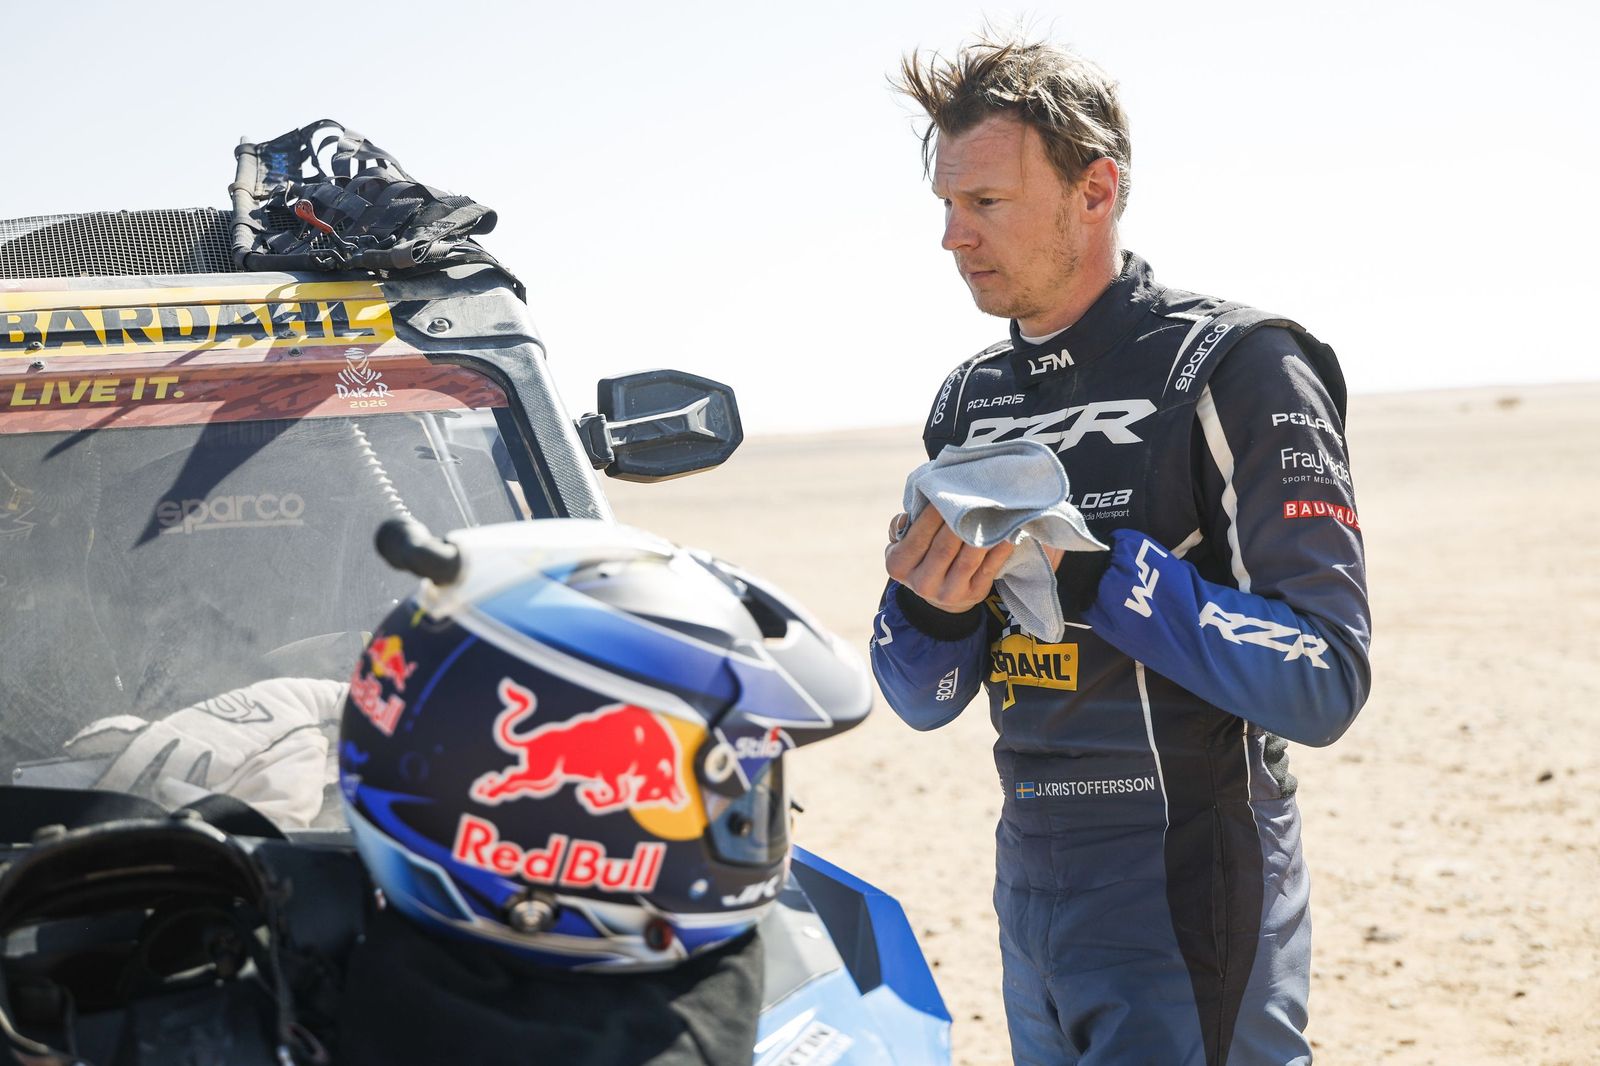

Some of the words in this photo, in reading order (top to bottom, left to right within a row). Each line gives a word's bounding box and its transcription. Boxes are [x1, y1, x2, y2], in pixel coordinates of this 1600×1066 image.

[0, 301, 375, 352] BARDAHL
[1028, 349, 1075, 375] LFM
[1175, 323, 1234, 392] sparco
[10, 379, 120, 406] LIVE
[131, 375, 185, 400] IT.
[335, 382, 395, 399] DAKAR
[966, 393, 1025, 412] POLARIS
[350, 400, 388, 409] 2026
[959, 399, 1158, 455] RZR
[1271, 412, 1343, 448] POLARIS
[1282, 475, 1311, 485] SPORT
[1314, 476, 1338, 486] MEDIA
[1066, 489, 1133, 509] LOEB
[157, 493, 305, 534] sparco
[1095, 508, 1130, 520] Motorsport
[1199, 601, 1330, 669] RZR
[1035, 776, 1156, 797] J.KRISTOFFERSSON
